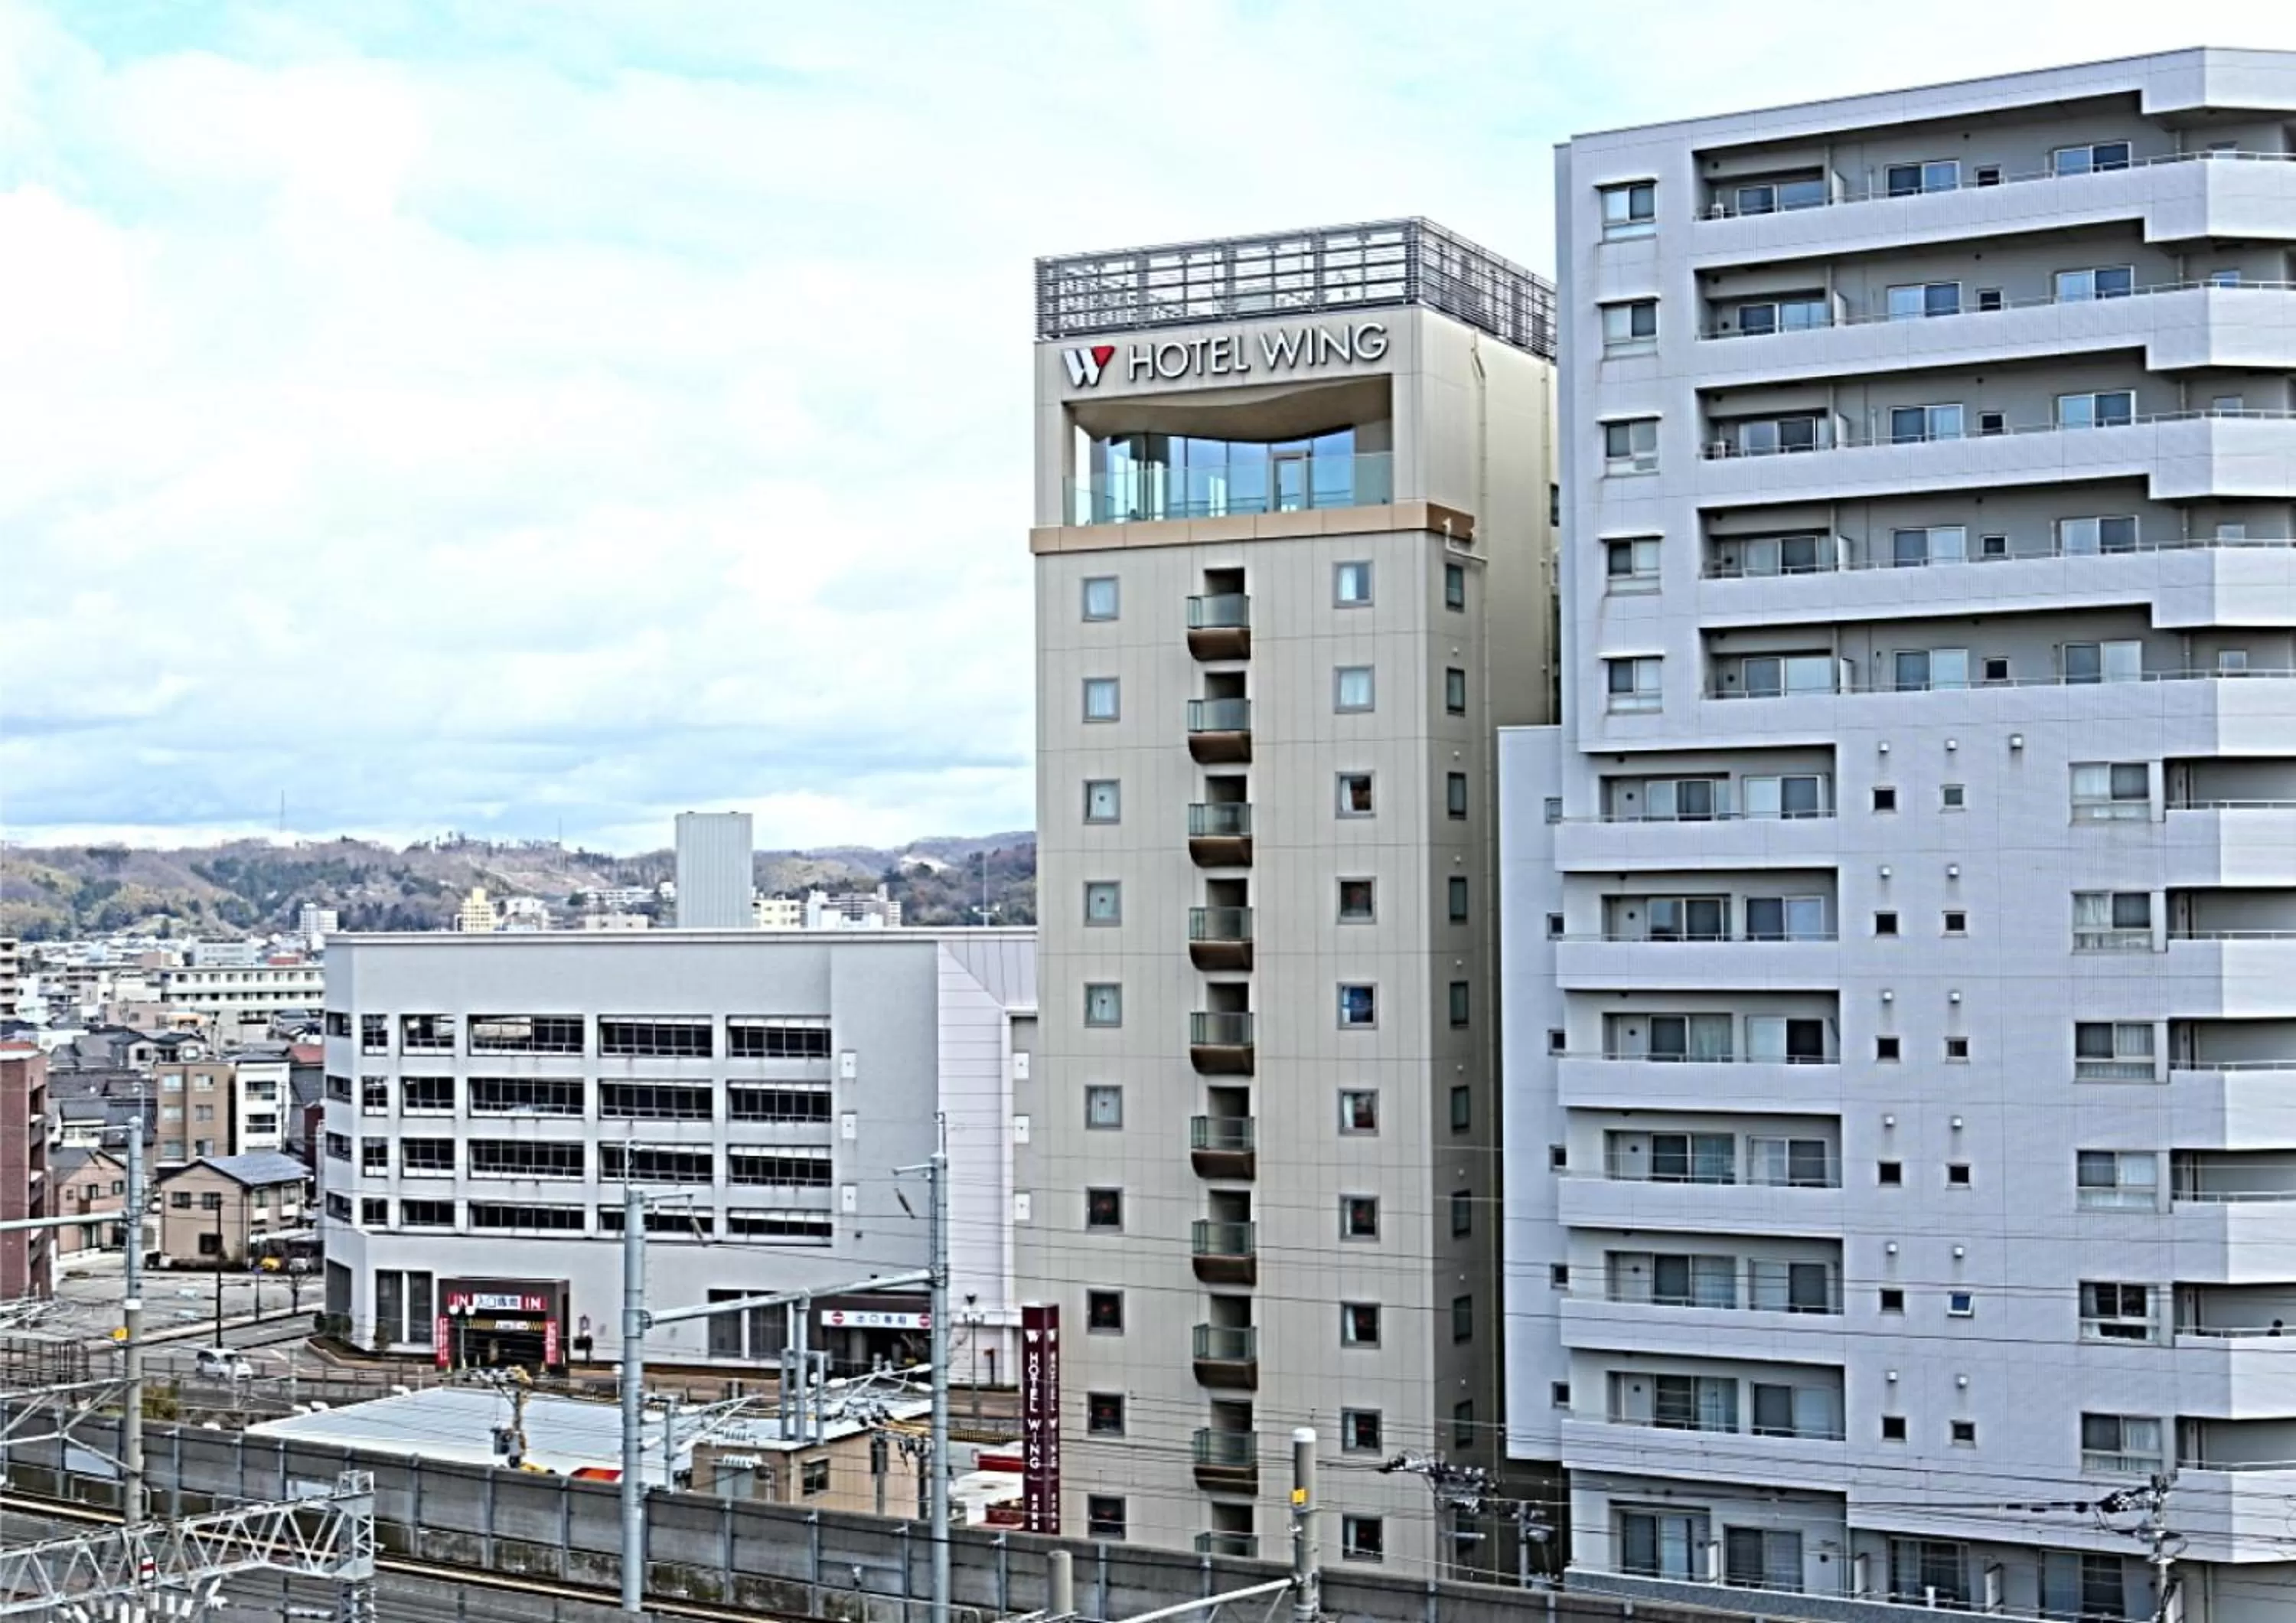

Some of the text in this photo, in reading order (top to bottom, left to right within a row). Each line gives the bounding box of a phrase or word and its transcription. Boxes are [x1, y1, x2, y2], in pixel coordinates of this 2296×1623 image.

[1128, 336, 1251, 382] HOTEL
[1259, 322, 1389, 370] WING
[525, 1296, 541, 1308] IN
[1028, 1351, 1039, 1412] HOTEL
[1027, 1419, 1041, 1470] WING
